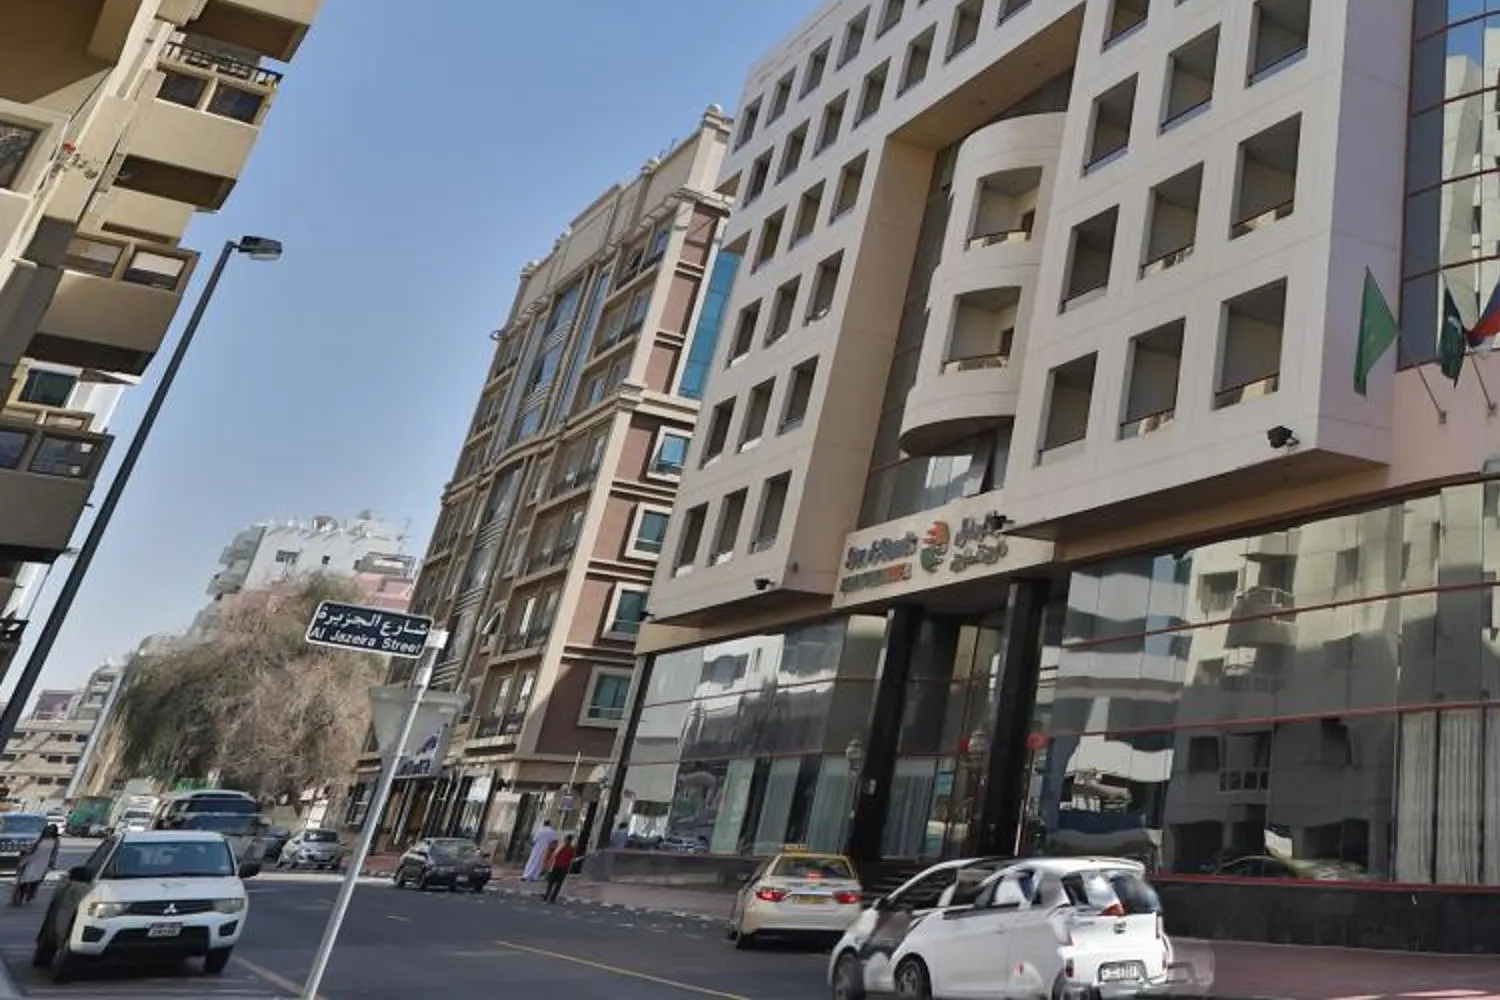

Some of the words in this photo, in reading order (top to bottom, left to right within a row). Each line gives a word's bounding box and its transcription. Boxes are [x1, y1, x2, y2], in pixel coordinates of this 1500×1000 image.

[317, 605, 383, 628] الجزيرة
[379, 619, 428, 637] شارع
[309, 626, 326, 639] Al
[381, 637, 421, 654] Street
